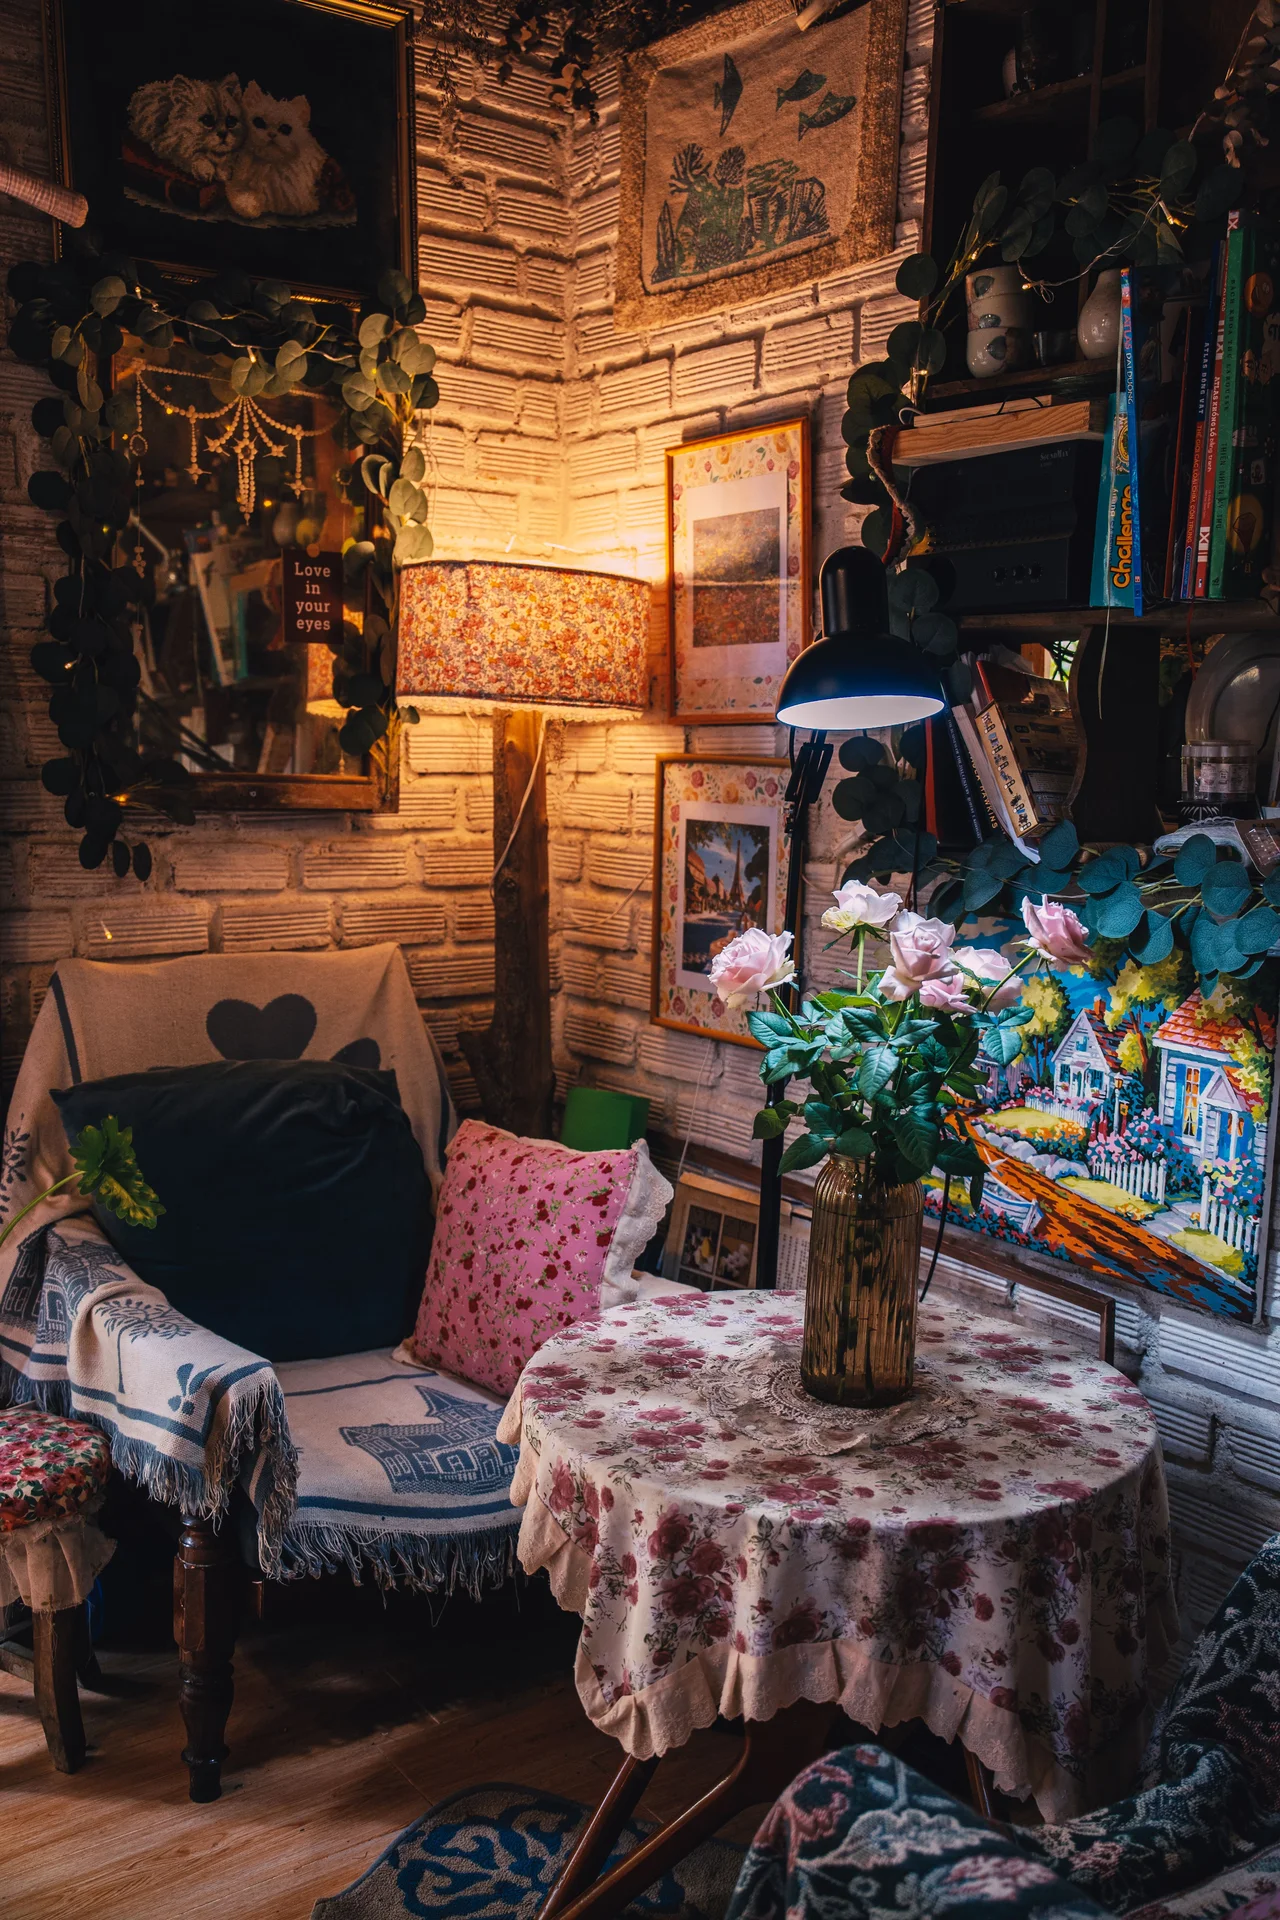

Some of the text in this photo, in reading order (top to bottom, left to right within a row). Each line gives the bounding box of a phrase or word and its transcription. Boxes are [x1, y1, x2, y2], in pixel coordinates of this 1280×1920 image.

[1121, 313, 1134, 349] ATLAS
[1201, 341, 1210, 369] ATLAS
[1211, 375, 1221, 400] ATLAS
[294, 562, 331, 577] Love
[305, 580, 321, 595] in
[295, 601, 331, 614] your
[296, 618, 331, 632] eyes
